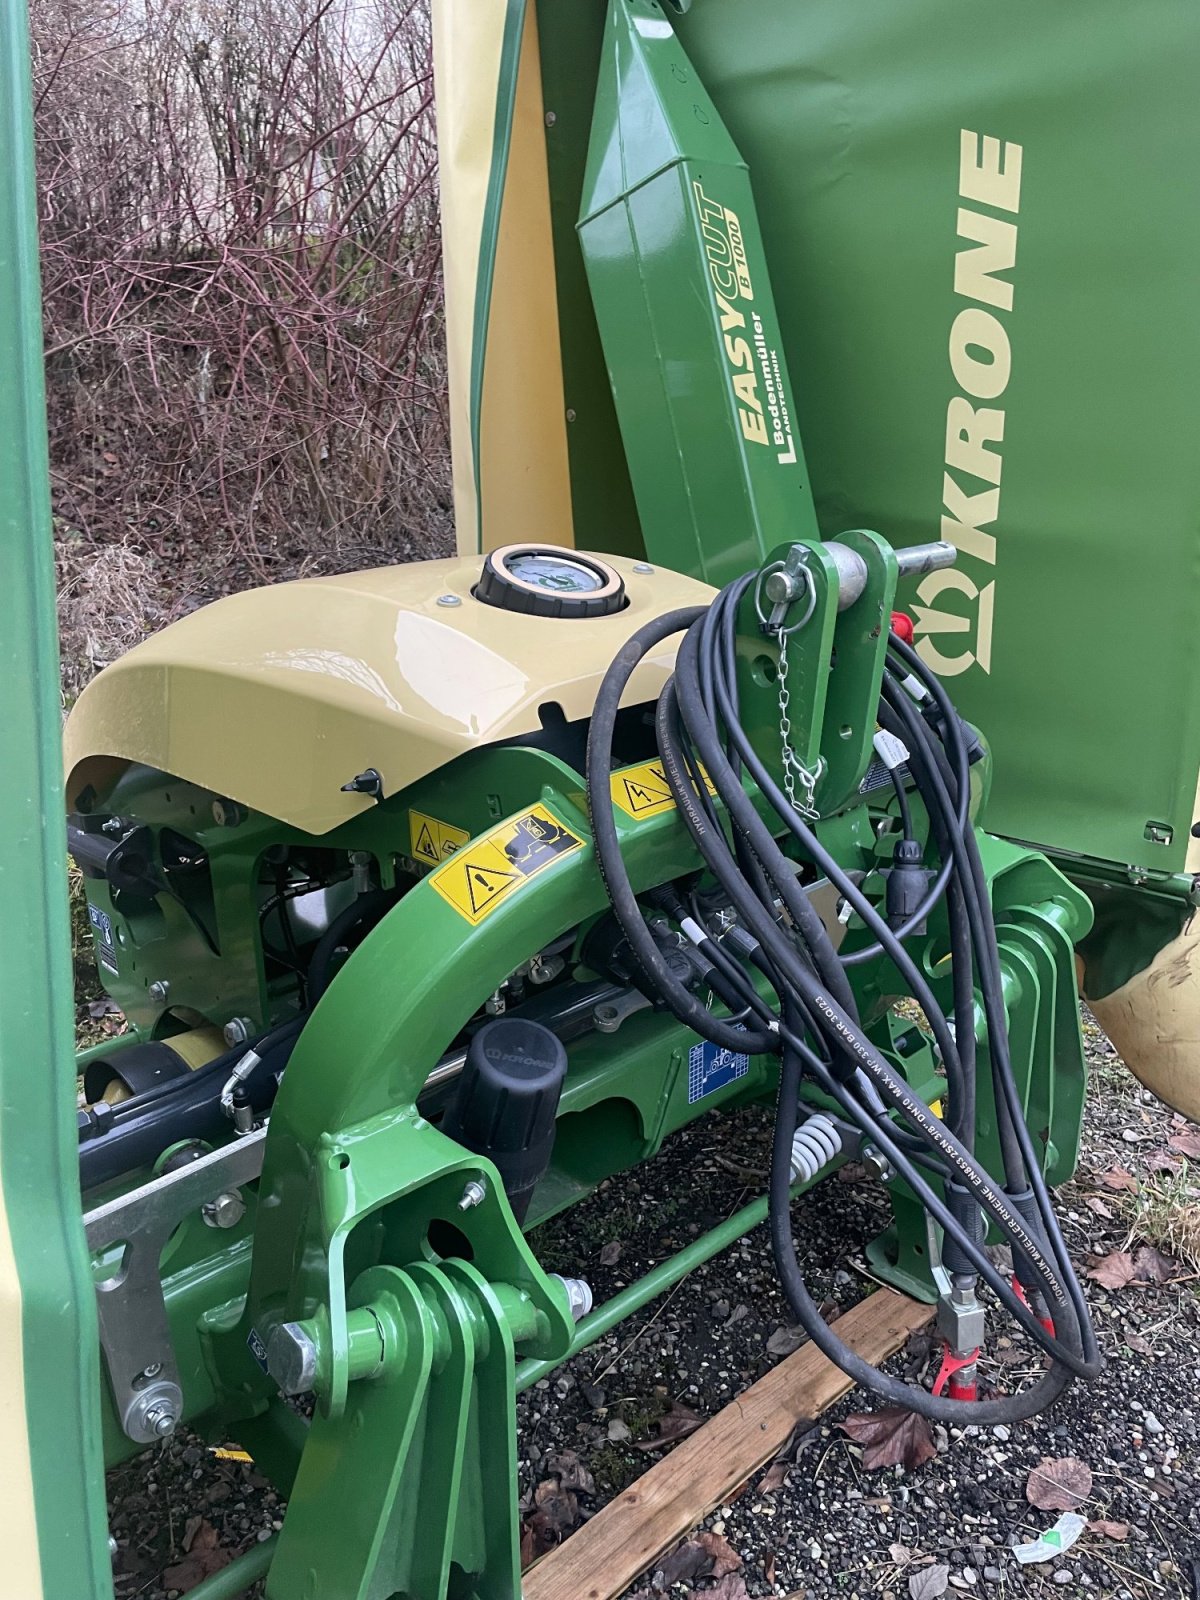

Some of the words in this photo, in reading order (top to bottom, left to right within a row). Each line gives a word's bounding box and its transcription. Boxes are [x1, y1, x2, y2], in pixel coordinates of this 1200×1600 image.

[729, 220, 746, 268] 1000
[740, 276, 750, 290] B
[693, 181, 770, 446] EASYCUT
[941, 128, 1023, 566] KRONE
[751, 311, 785, 446] Bodenmüller
[770, 349, 797, 464] LANDTECHNIK
[663, 748, 681, 787] MUELLER
[677, 783, 706, 836] HYDRAULIK
[836, 1022, 856, 1043] BAR
[853, 1042, 869, 1060] 330
[866, 1059, 882, 1075] WP
[881, 1072, 903, 1098] MAX.
[902, 1098, 926, 1123] DN10
[939, 1138, 959, 1159] 2SN
[955, 1156, 983, 1187] EN853
[980, 1184, 1011, 1221] RHEINE
[1007, 1220, 1041, 1260] MUELLER
[1036, 1257, 1068, 1308] HYDRAULIK
